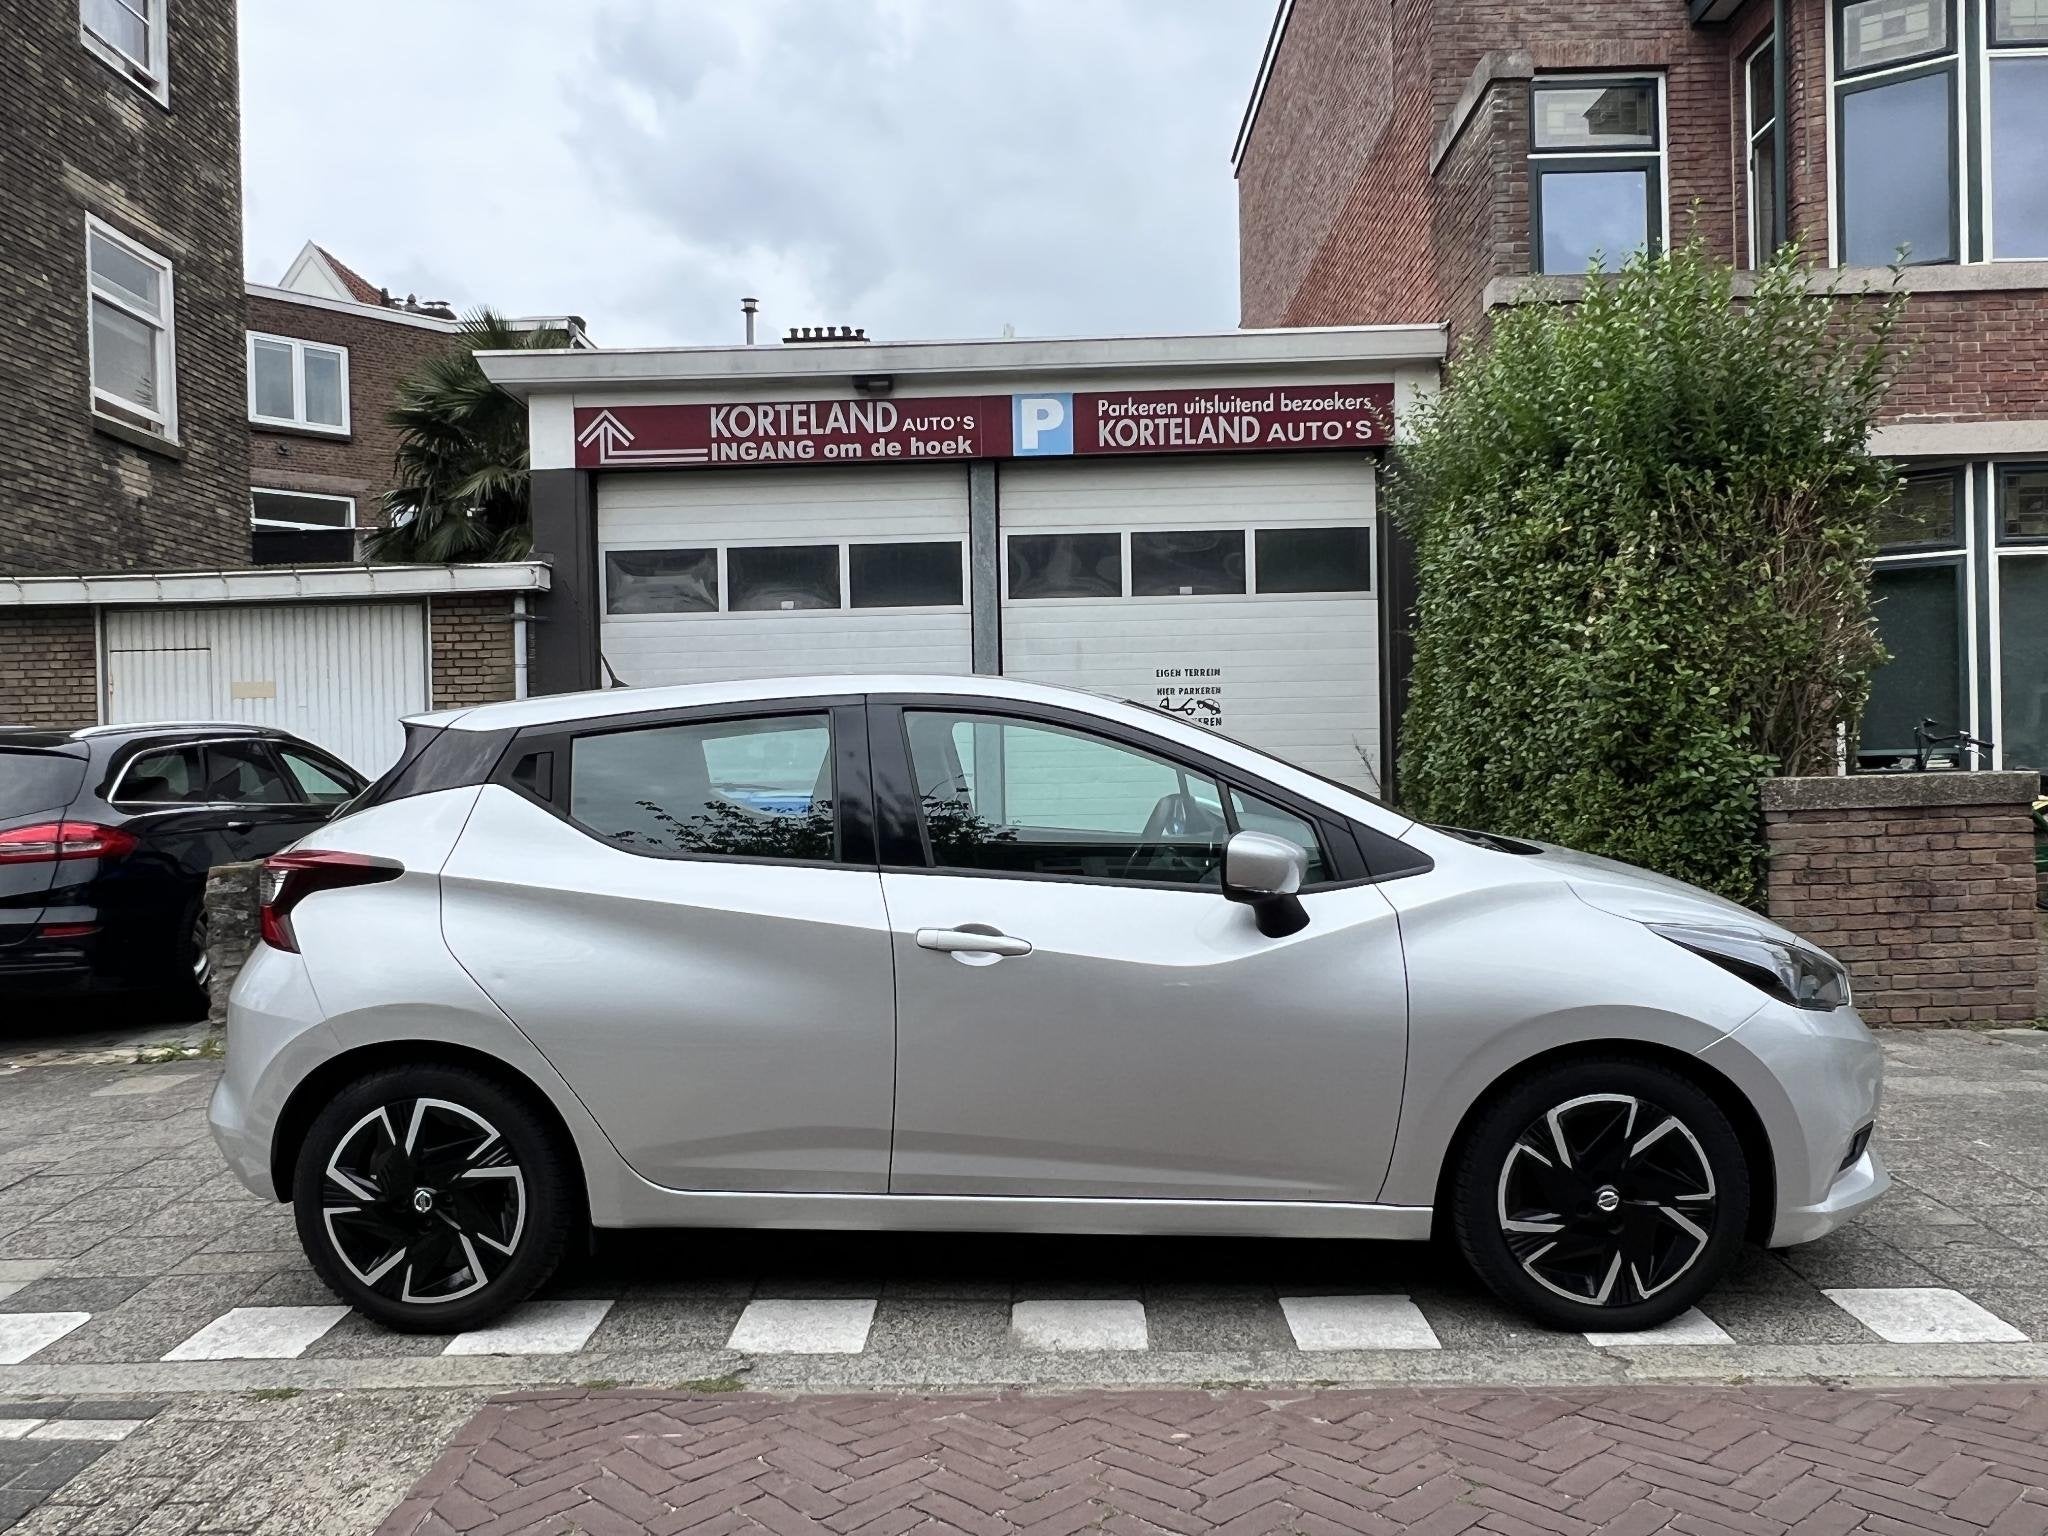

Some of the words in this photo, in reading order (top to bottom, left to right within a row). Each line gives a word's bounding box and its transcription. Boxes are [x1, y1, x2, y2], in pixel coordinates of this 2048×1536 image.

[1098, 397, 1178, 417] Parkeren
[1184, 393, 1274, 415] uitsluitend
[1280, 391, 1372, 413] bezoekers
[710, 401, 898, 438] KORTELAND
[902, 415, 975, 432] AUTO'S
[1021, 398, 1065, 450] P
[1098, 415, 1261, 447] KORTELAND
[1267, 420, 1372, 443] AUTO'S
[711, 440, 815, 462] INGANG
[823, 442, 862, 458] om
[871, 438, 901, 457] de
[910, 436, 973, 456] hoek
[1156, 669, 1181, 677] EIGEN
[1184, 668, 1221, 677] TERREIN
[1178, 686, 1221, 695] PARKEREN
